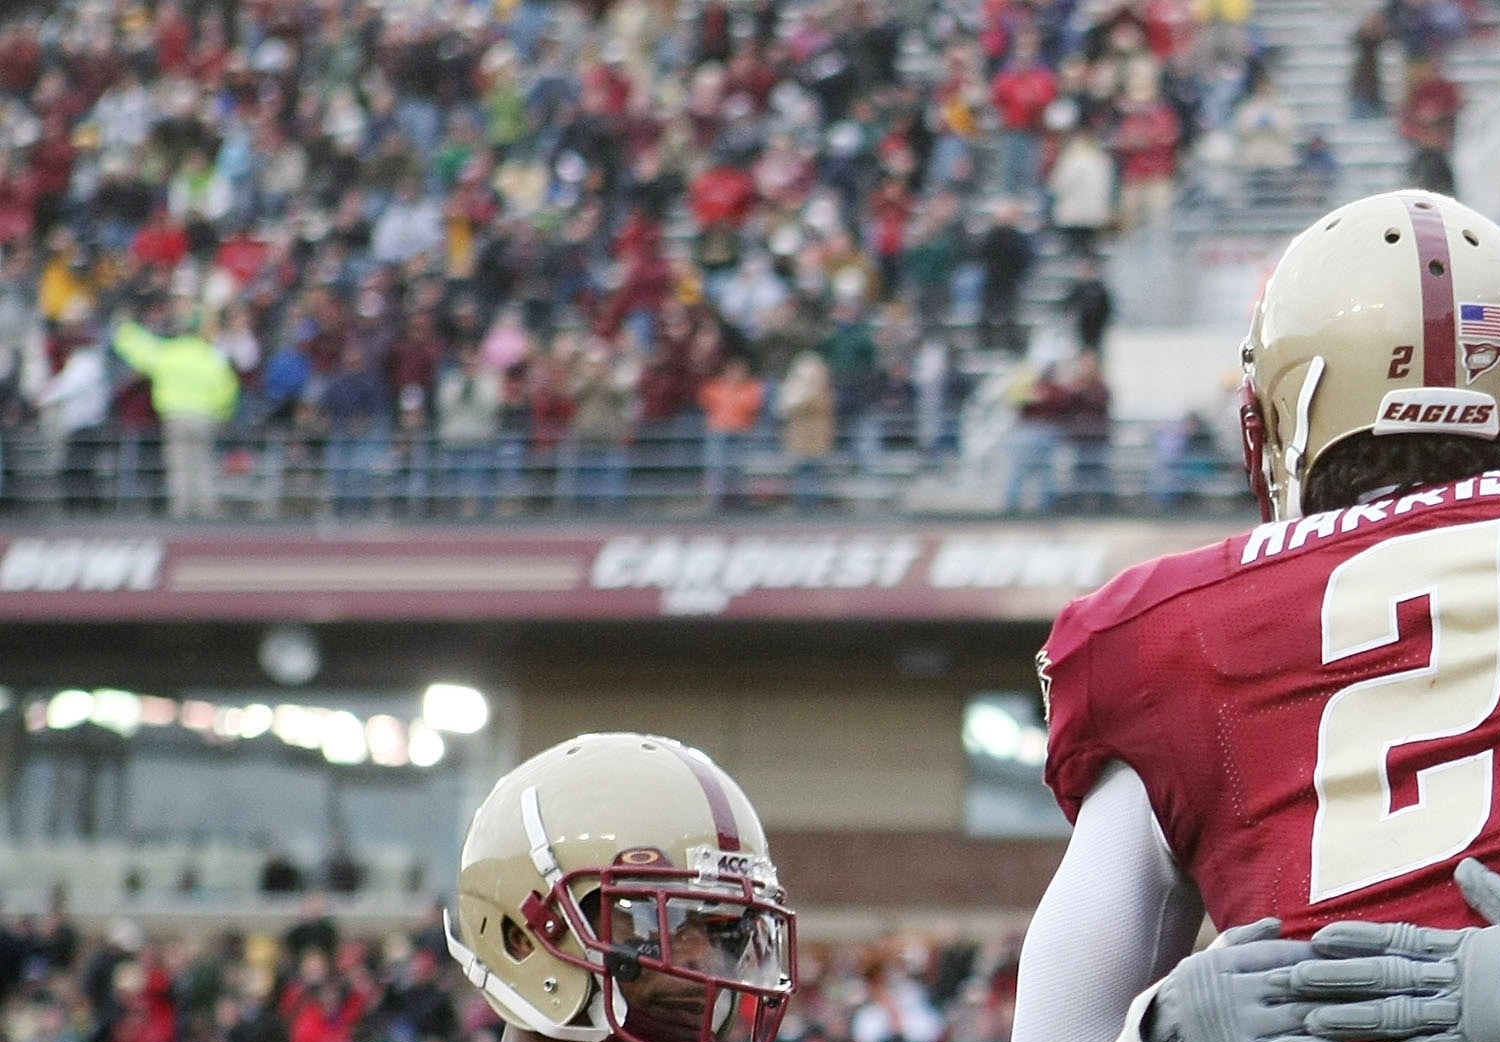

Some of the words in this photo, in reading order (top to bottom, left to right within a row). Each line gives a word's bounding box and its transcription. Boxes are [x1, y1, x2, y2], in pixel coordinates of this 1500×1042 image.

[1387, 345, 1414, 380] 2
[1382, 402, 1495, 425] EAGLES
[717, 855, 749, 874] ACC
